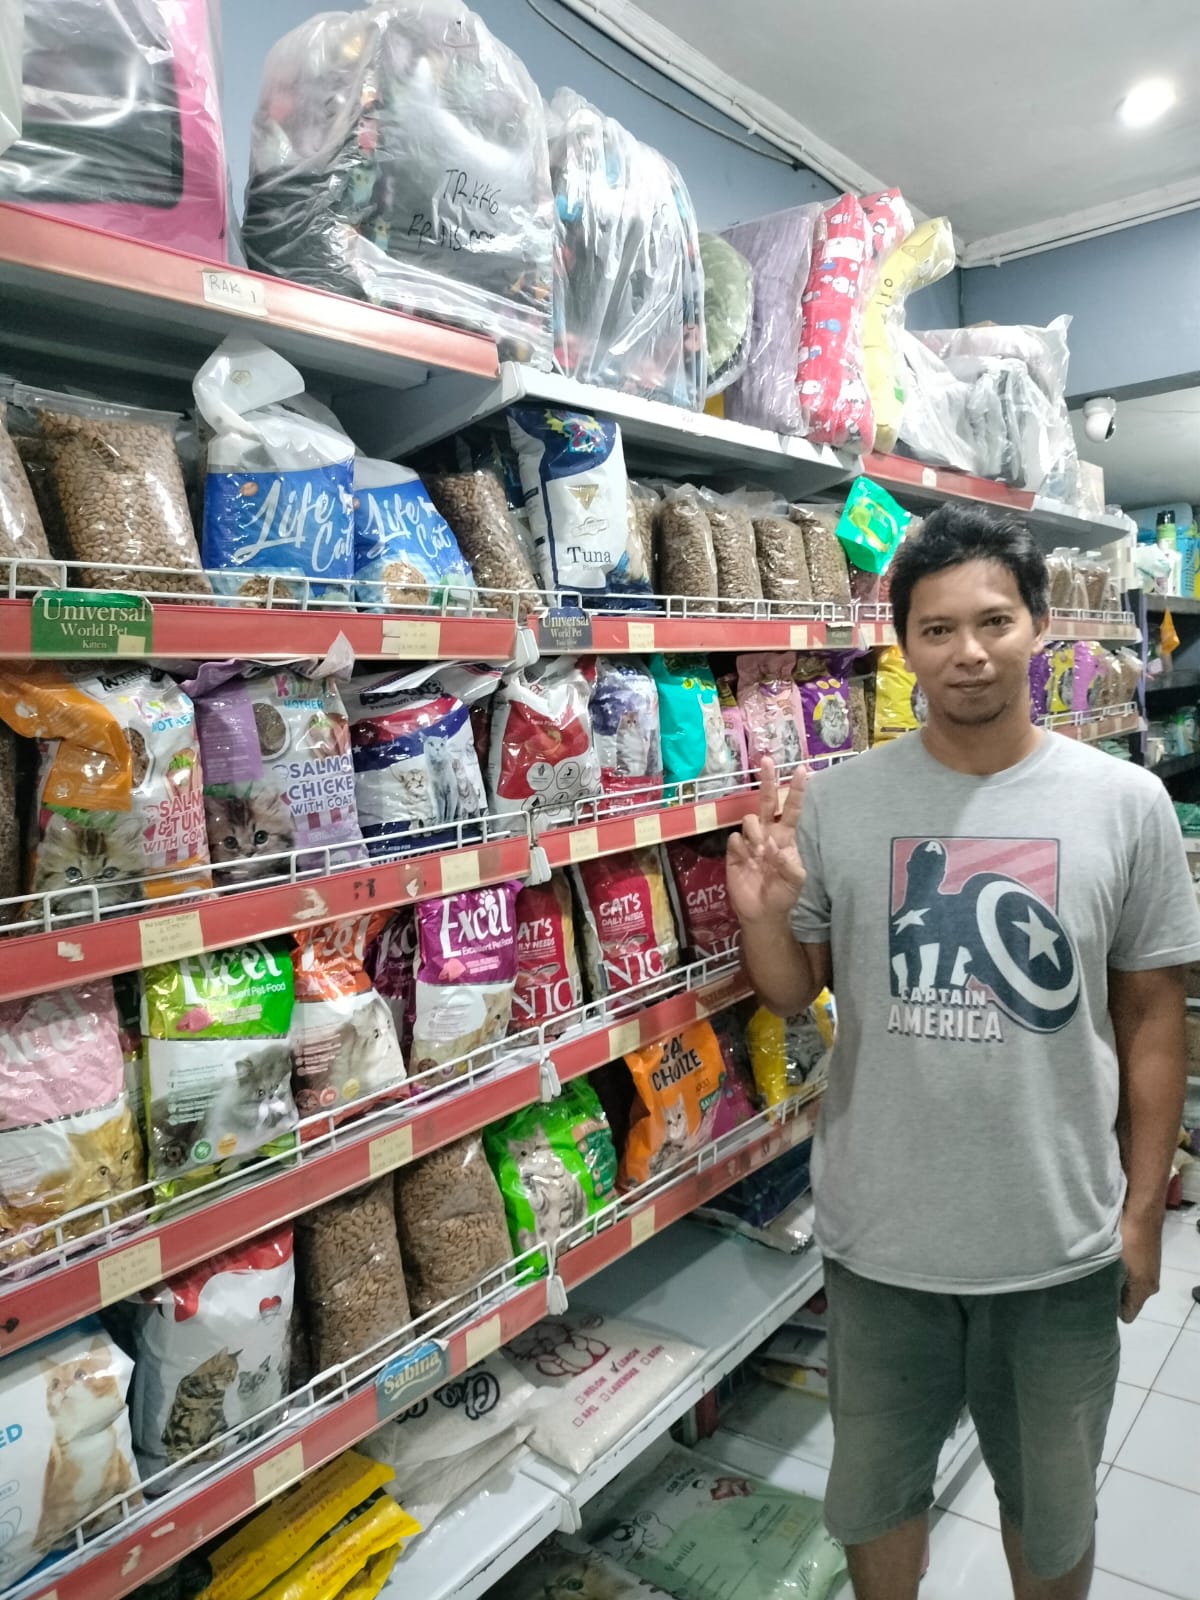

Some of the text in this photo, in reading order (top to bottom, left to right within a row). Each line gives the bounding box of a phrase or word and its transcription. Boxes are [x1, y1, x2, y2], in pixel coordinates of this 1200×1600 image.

[208, 274, 241, 294] RAK
[233, 479, 336, 565] Life
[359, 493, 419, 559] Life
[311, 522, 353, 573] Cat
[415, 524, 452, 558] Cat
[567, 546, 612, 565] Tuna
[42, 598, 146, 622] Universal
[542, 612, 590, 628] Universal
[60, 623, 128, 637] World Pet
[550, 627, 582, 639] World Pet
[82, 640, 107, 649] Kitten
[291, 801, 324, 816] WITH
[143, 835, 178, 854] WITH
[925, 841, 943, 855] A
[599, 893, 642, 917] CAT'S
[686, 884, 726, 906] CAT'S
[440, 888, 512, 959] Excel
[518, 917, 553, 942] AT'S
[602, 915, 623, 927] DAILY
[251, 986, 265, 997] Pet
[265, 982, 286, 994] Food
[900, 986, 987, 1008] CAPTAIN
[888, 1004, 1004, 1042] AMERICA
[651, 1048, 702, 1092] CHOIZE
[383, 1351, 441, 1395] Sabina
